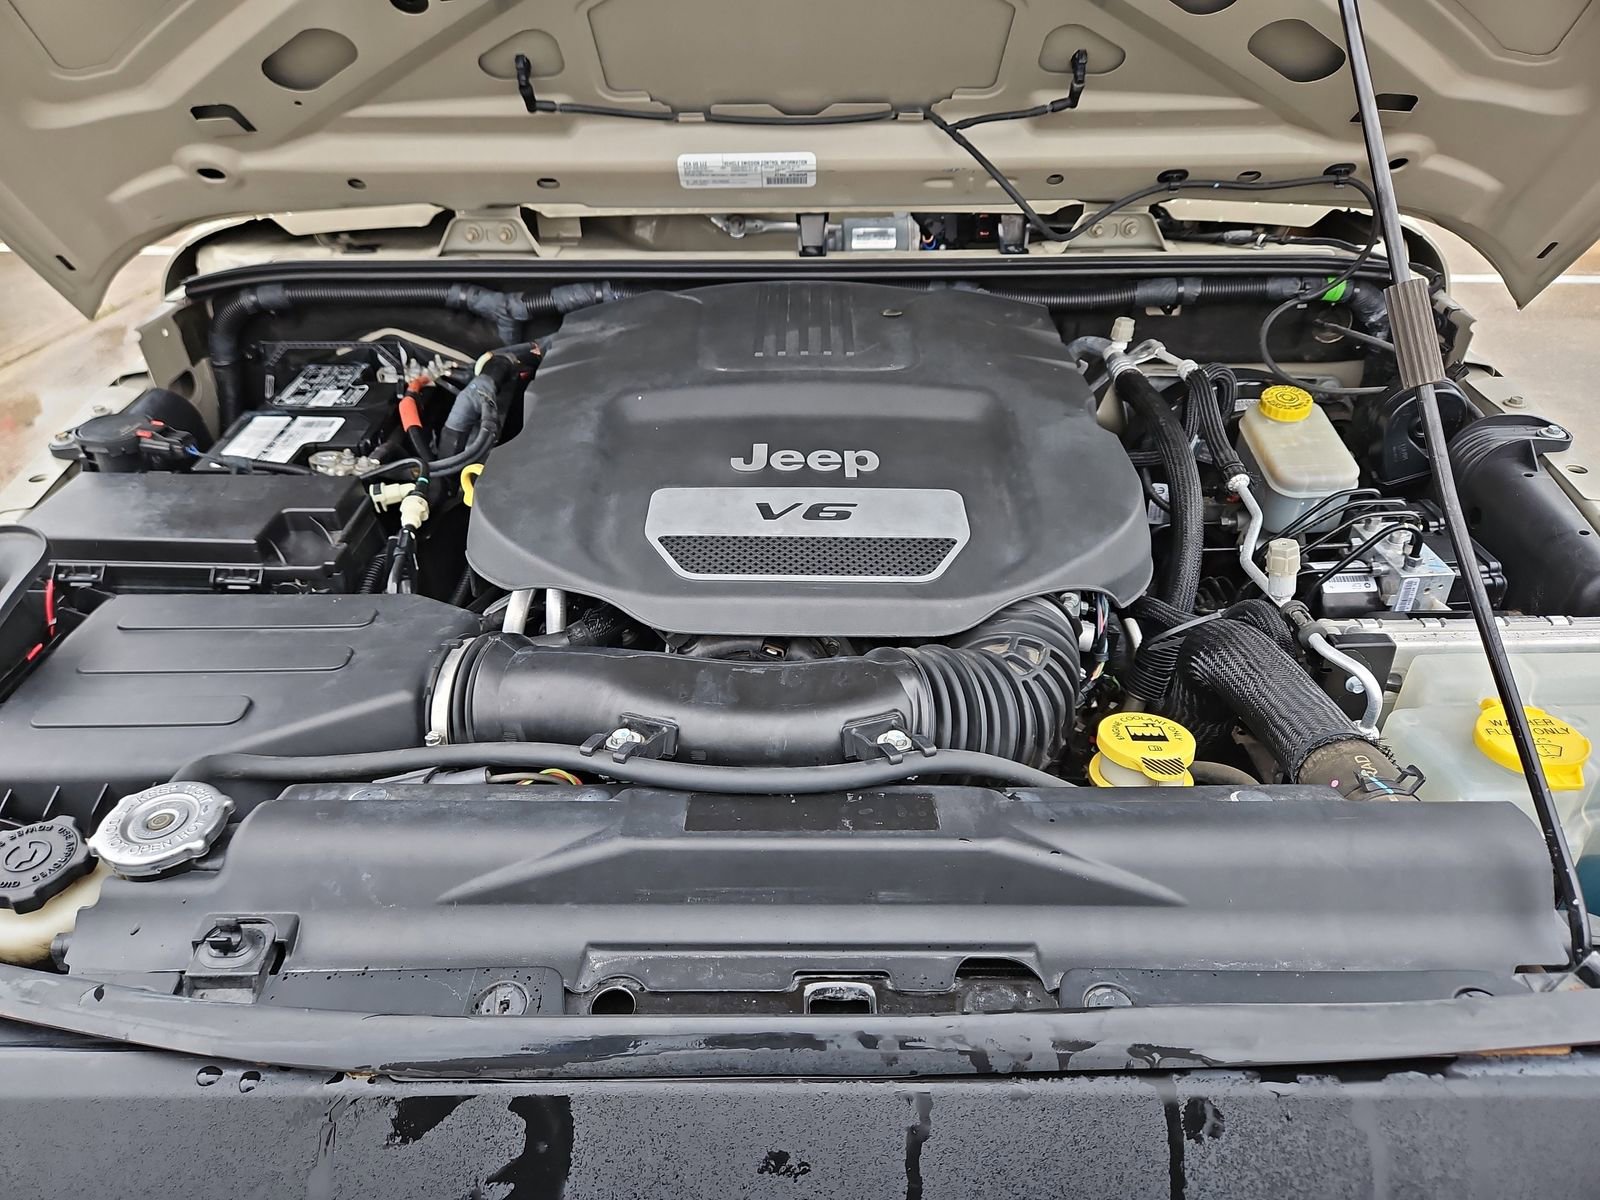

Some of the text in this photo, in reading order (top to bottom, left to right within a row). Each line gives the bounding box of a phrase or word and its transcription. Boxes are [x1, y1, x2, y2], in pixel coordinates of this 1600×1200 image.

[730, 443, 880, 478] Jeep
[755, 502, 858, 521] V6
[1111, 715, 1183, 741] ENGINE COOLANT ONLY
[1532, 727, 1571, 735] ONLY
[136, 785, 179, 803] KEEP
[8, 825, 54, 841] POWER
[129, 839, 173, 855] OPEN
[175, 819, 206, 841] HOT
[32, 827, 75, 882] USE APPROVED
